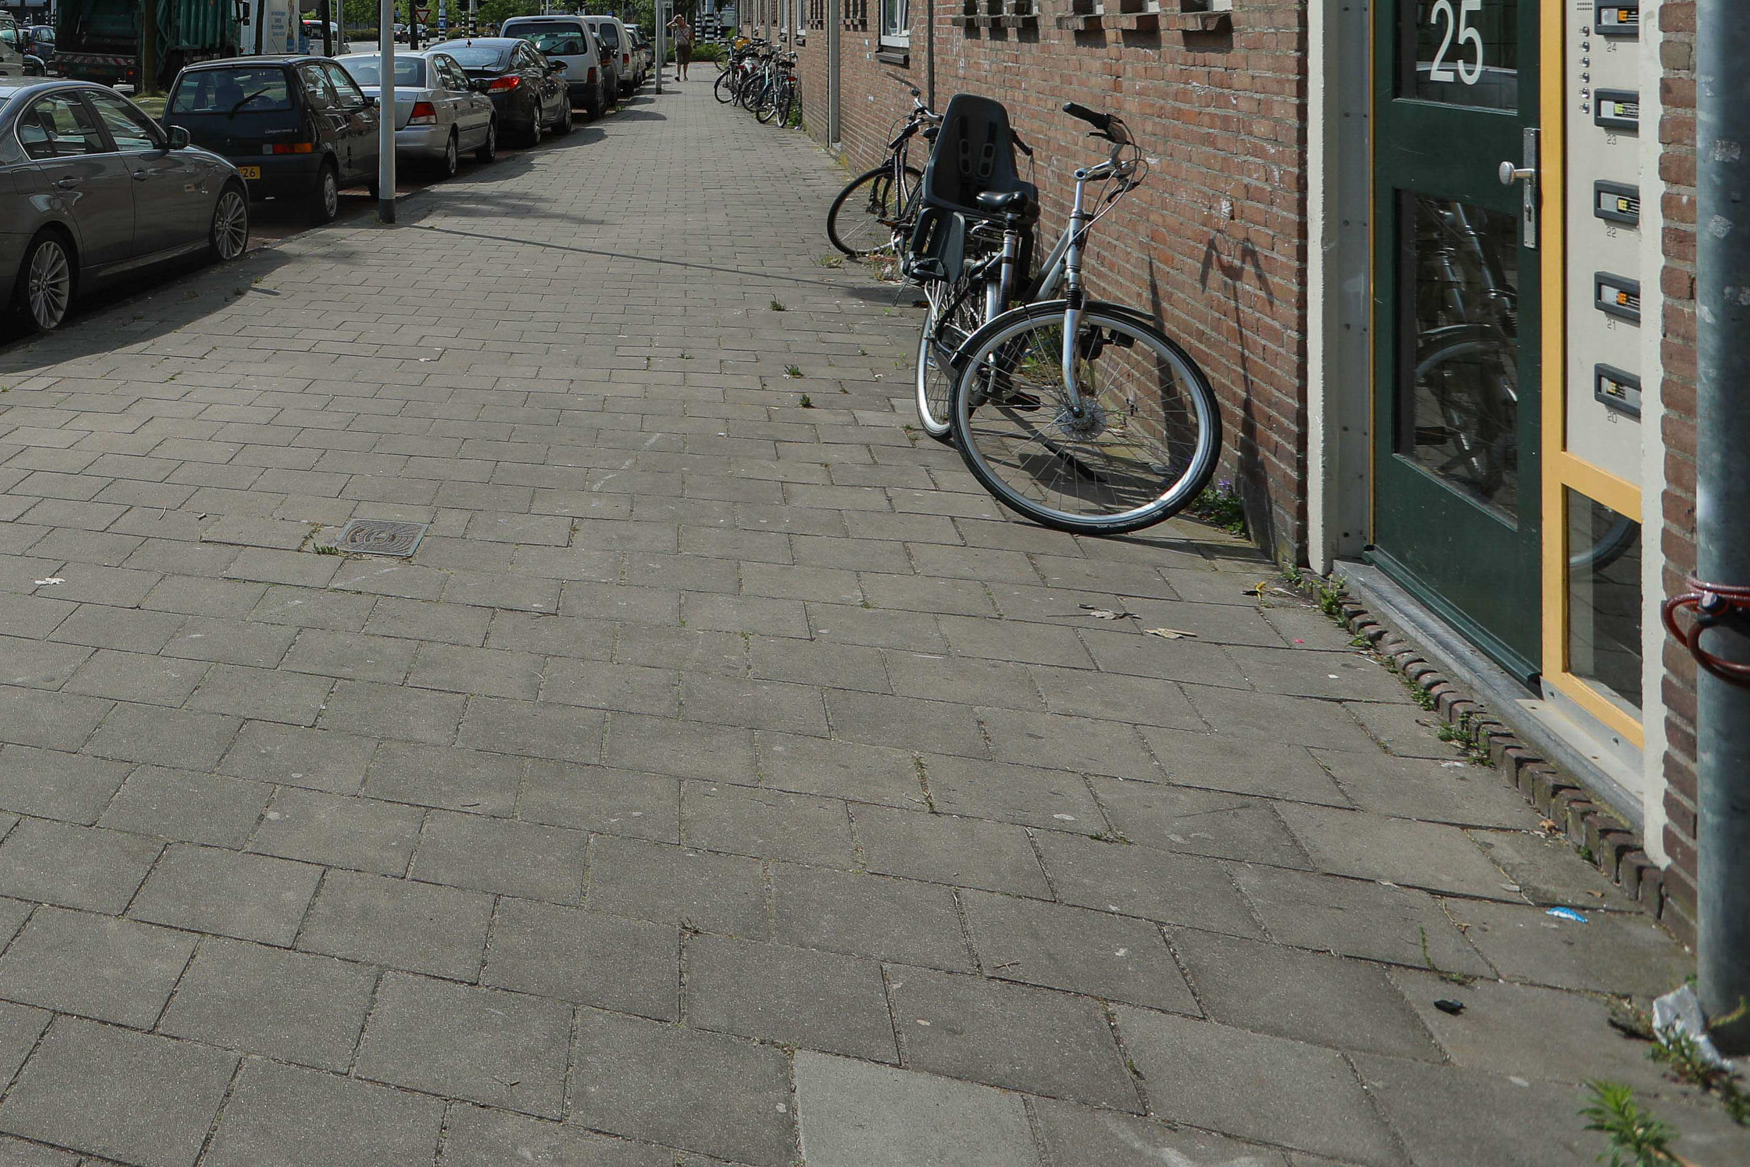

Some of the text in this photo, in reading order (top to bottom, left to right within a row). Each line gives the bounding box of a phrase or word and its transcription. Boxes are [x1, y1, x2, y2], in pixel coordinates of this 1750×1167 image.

[1606, 41, 1617, 53] 24
[1606, 134, 1617, 145] 23
[241, 168, 256, 178] 26
[1606, 226, 1617, 238] 22
[1606, 318, 1617, 330] 21
[1606, 411, 1618, 424] 20
